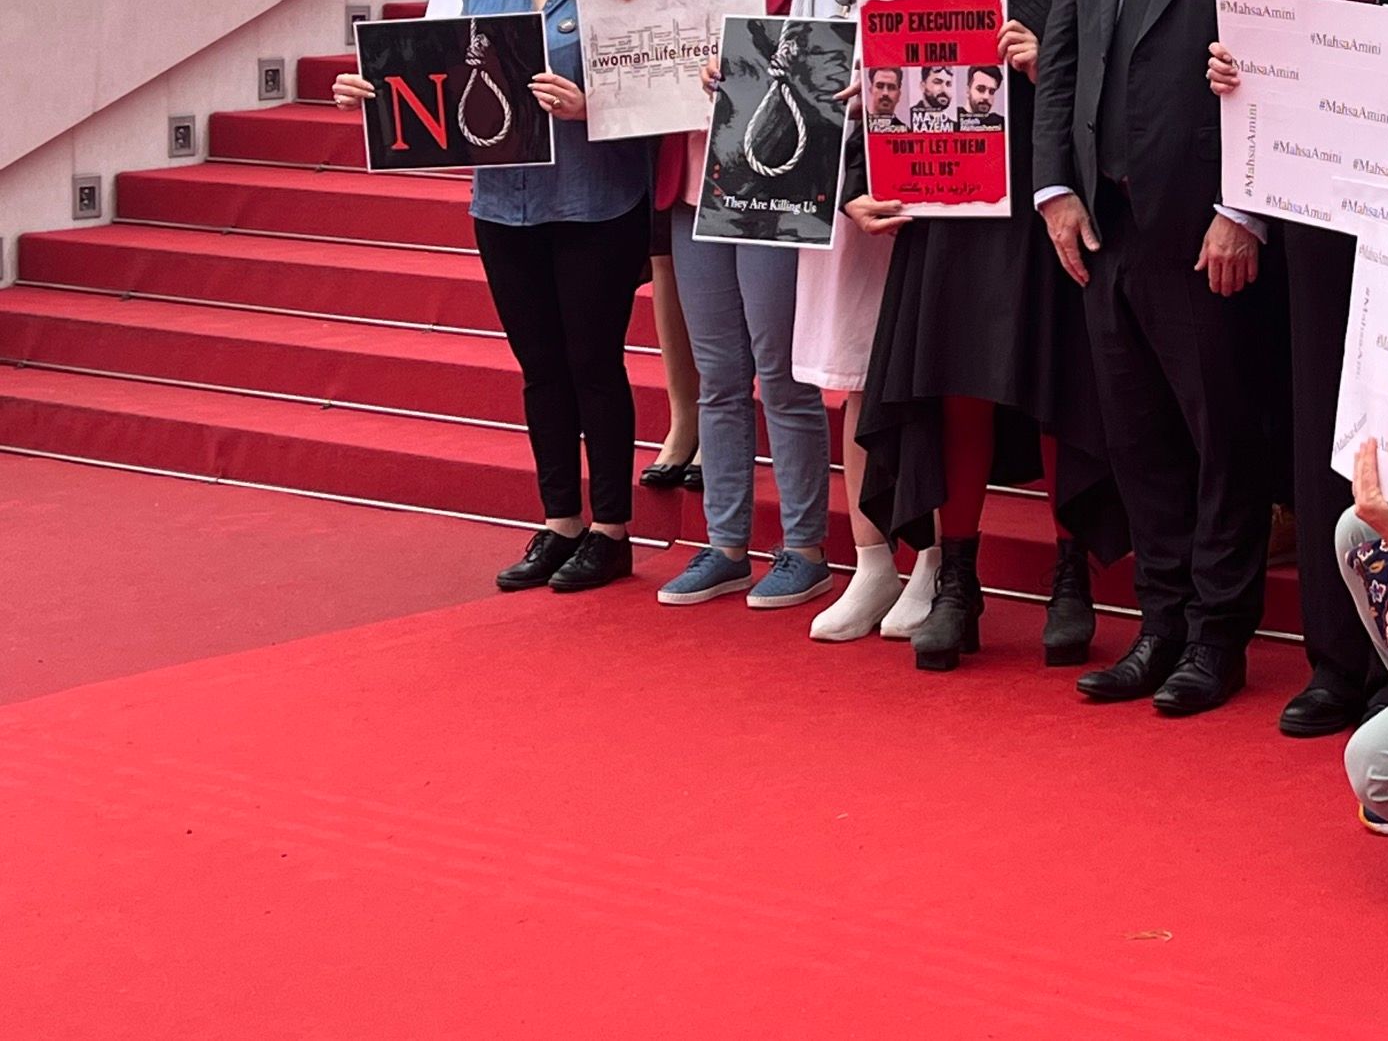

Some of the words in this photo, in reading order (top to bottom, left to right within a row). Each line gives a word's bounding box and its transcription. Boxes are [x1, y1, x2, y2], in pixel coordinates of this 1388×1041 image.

[1220, 0, 1296, 21] #MahsaAmini
[867, 13, 904, 34] STOP
[907, 10, 997, 33] EXECUTIONS
[905, 43, 920, 63] IN
[924, 42, 958, 63] IRAN
[1310, 33, 1381, 55] #MahsaAmini
[929, 139, 949, 154] LET
[952, 138, 986, 154] THEM
[1244, 103, 1257, 196] #MahsaAmini
[1273, 139, 1342, 164] #MahsaAmini
[911, 162, 935, 176] KILL
[723, 195, 748, 212] They
[748, 197, 768, 211] Are
[769, 199, 801, 216] Killing
[803, 201, 818, 214] Us
[1266, 195, 1333, 222] #MahsaAmini
